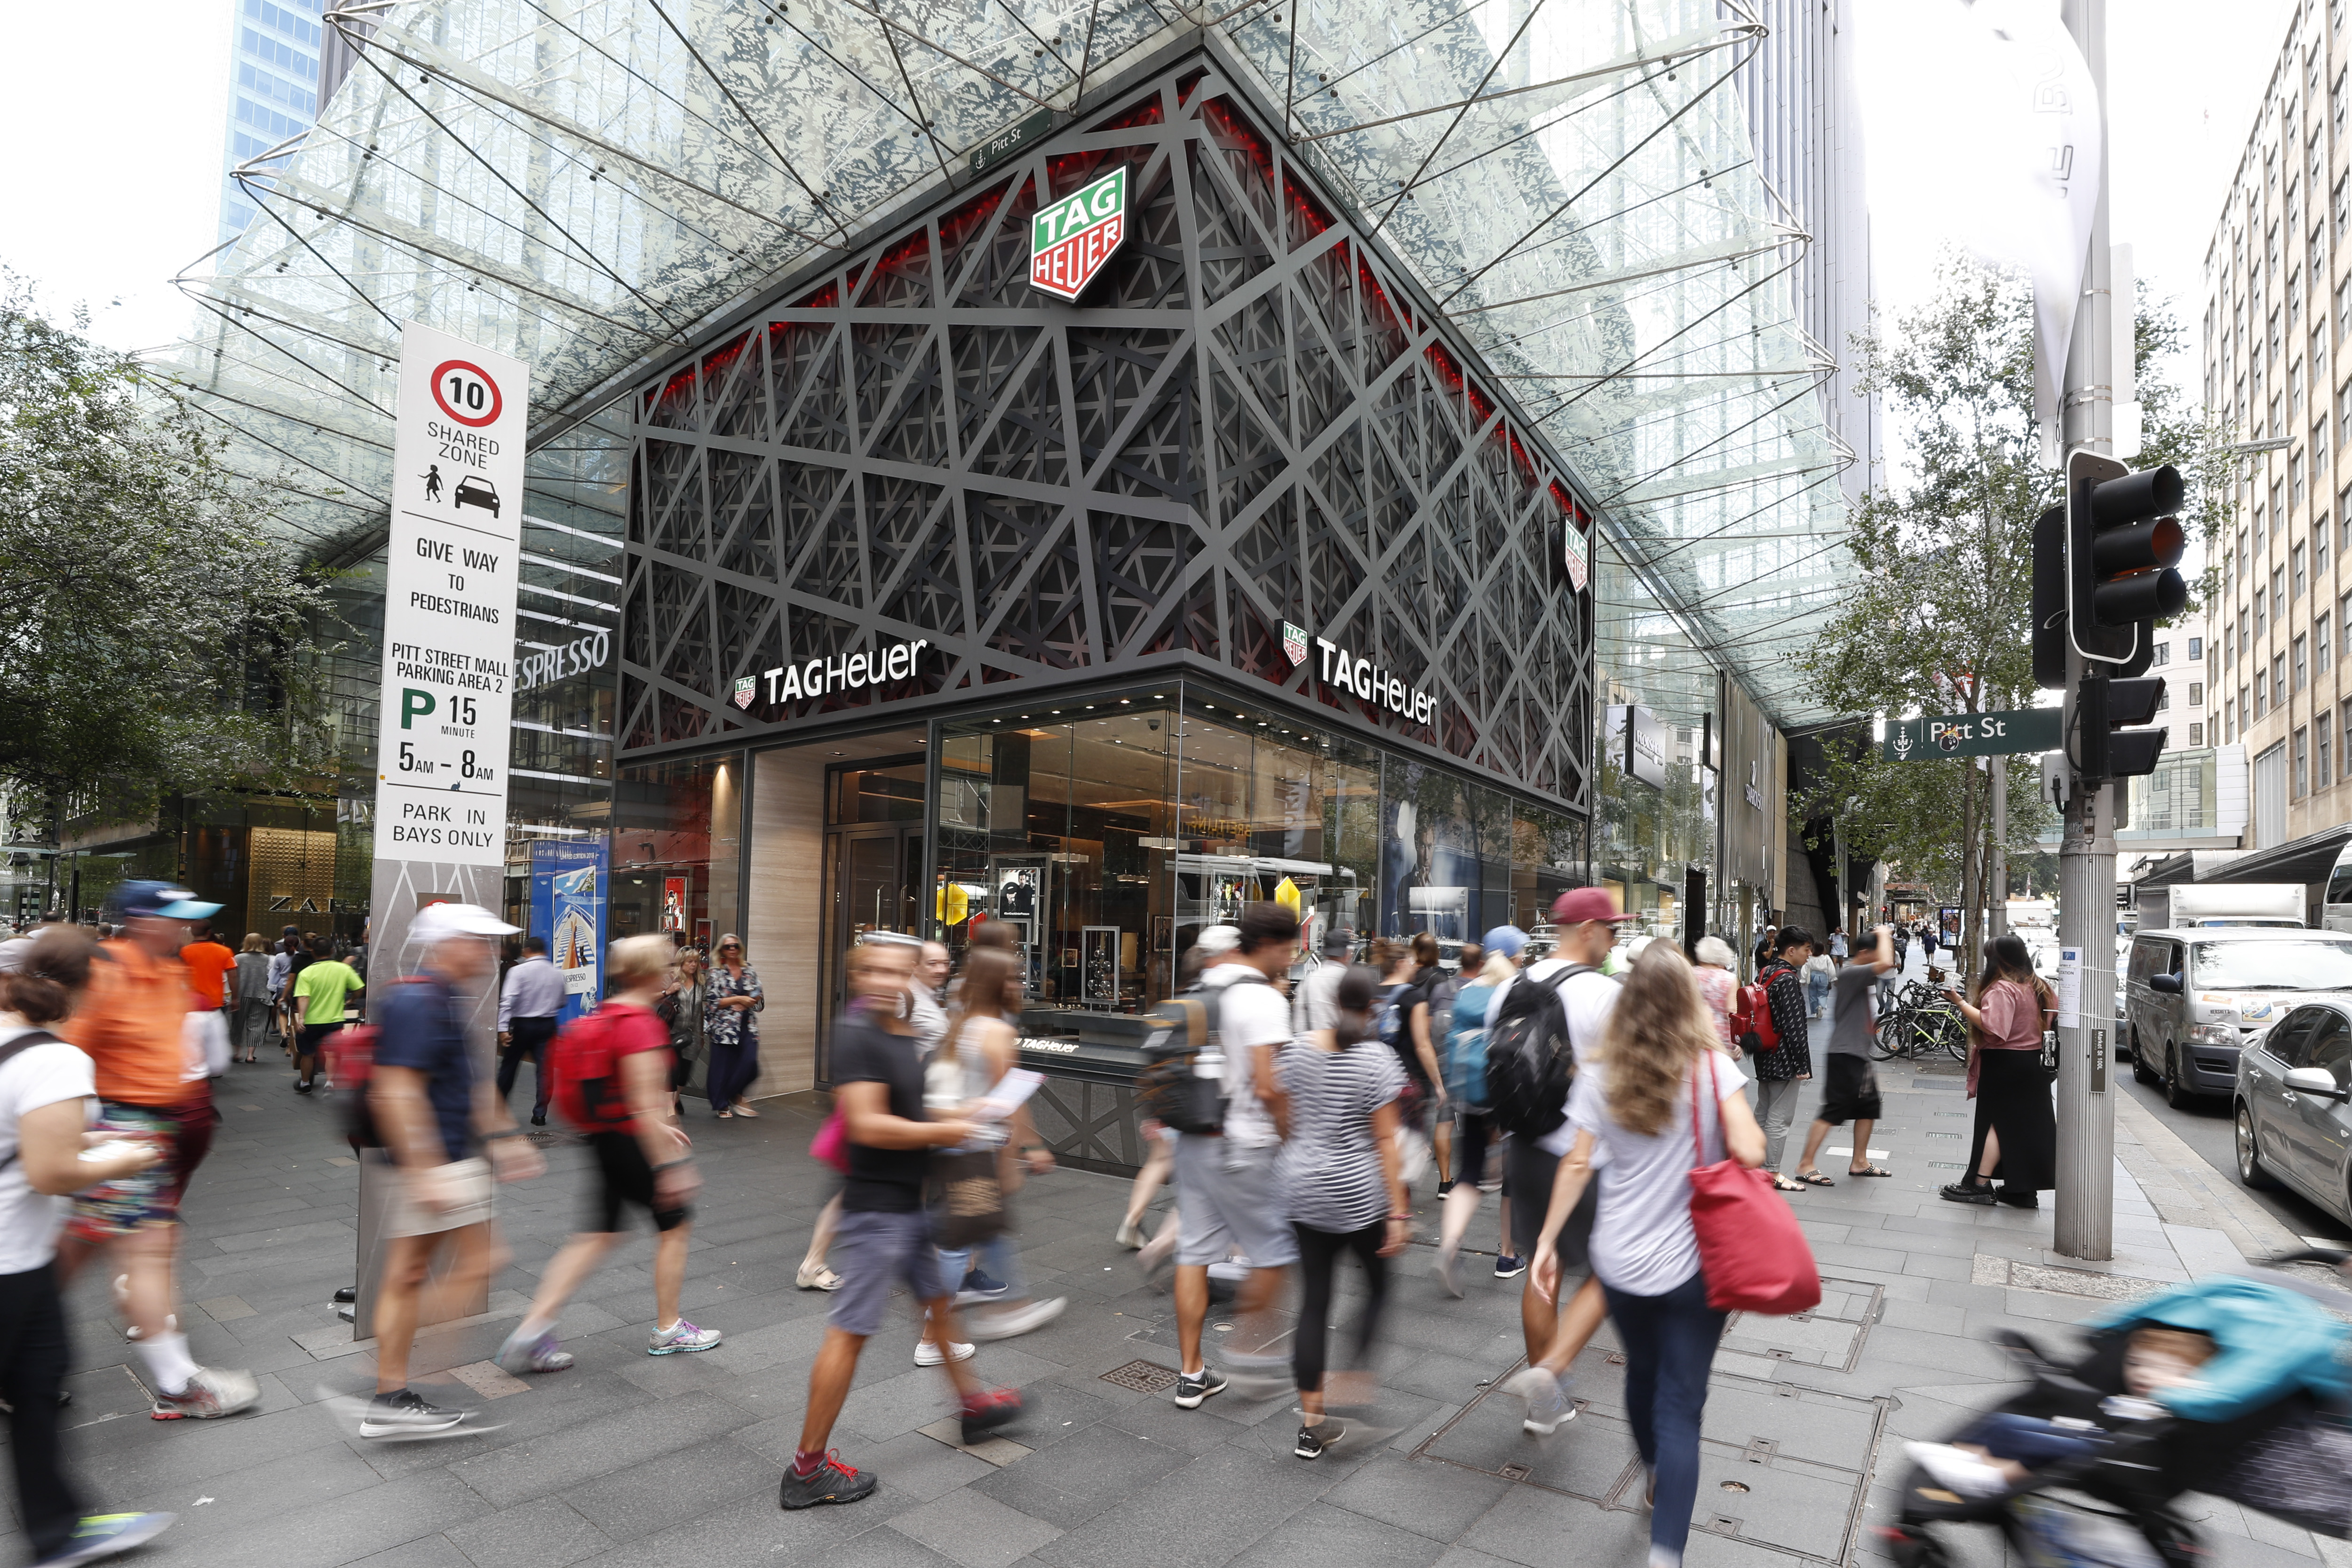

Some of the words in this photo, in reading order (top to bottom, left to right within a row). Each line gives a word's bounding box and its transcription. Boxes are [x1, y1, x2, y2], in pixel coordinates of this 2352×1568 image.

[991, 134, 1009, 155] Pitt
[1011, 128, 1021, 143] St
[1040, 180, 1116, 243] TAG
[1036, 219, 1119, 289] HEUER
[449, 376, 484, 410] 10
[427, 422, 500, 456] SHARED
[438, 442, 488, 470] ZONE
[417, 537, 453, 564] GIVE
[462, 548, 499, 573] WAY
[1568, 526, 1586, 561] TAG
[448, 573, 464, 591] TO
[1567, 549, 1586, 587] HEUER
[411, 591, 499, 623] PEDESTRIANS
[1286, 624, 1307, 645] TAG
[392, 642, 422, 660] PITT
[425, 648, 471, 670] STREET
[475, 659, 509, 677] MALL
[1284, 640, 1306, 665] HEUER
[397, 661, 454, 686] PARKING
[458, 672, 491, 692] AREA
[495, 679, 503, 693] 2
[737, 677, 754, 691] TAG
[764, 638, 927, 705] TAGHeuer
[1317, 636, 1438, 725] TAGHeuer
[400, 687, 437, 730] P
[449, 695, 477, 726] 15
[736, 690, 754, 708] HEUER
[441, 725, 476, 739] MINUTE
[1981, 717, 2006, 738] St
[399, 741, 434, 774] 5AM
[461, 749, 493, 781] 8AM
[403, 803, 452, 823] PARK
[468, 809, 485, 825] IN
[393, 825, 441, 844] BAYS
[448, 829, 493, 848] ONLY
[1022, 1038, 1080, 1053] TAGHeuer
